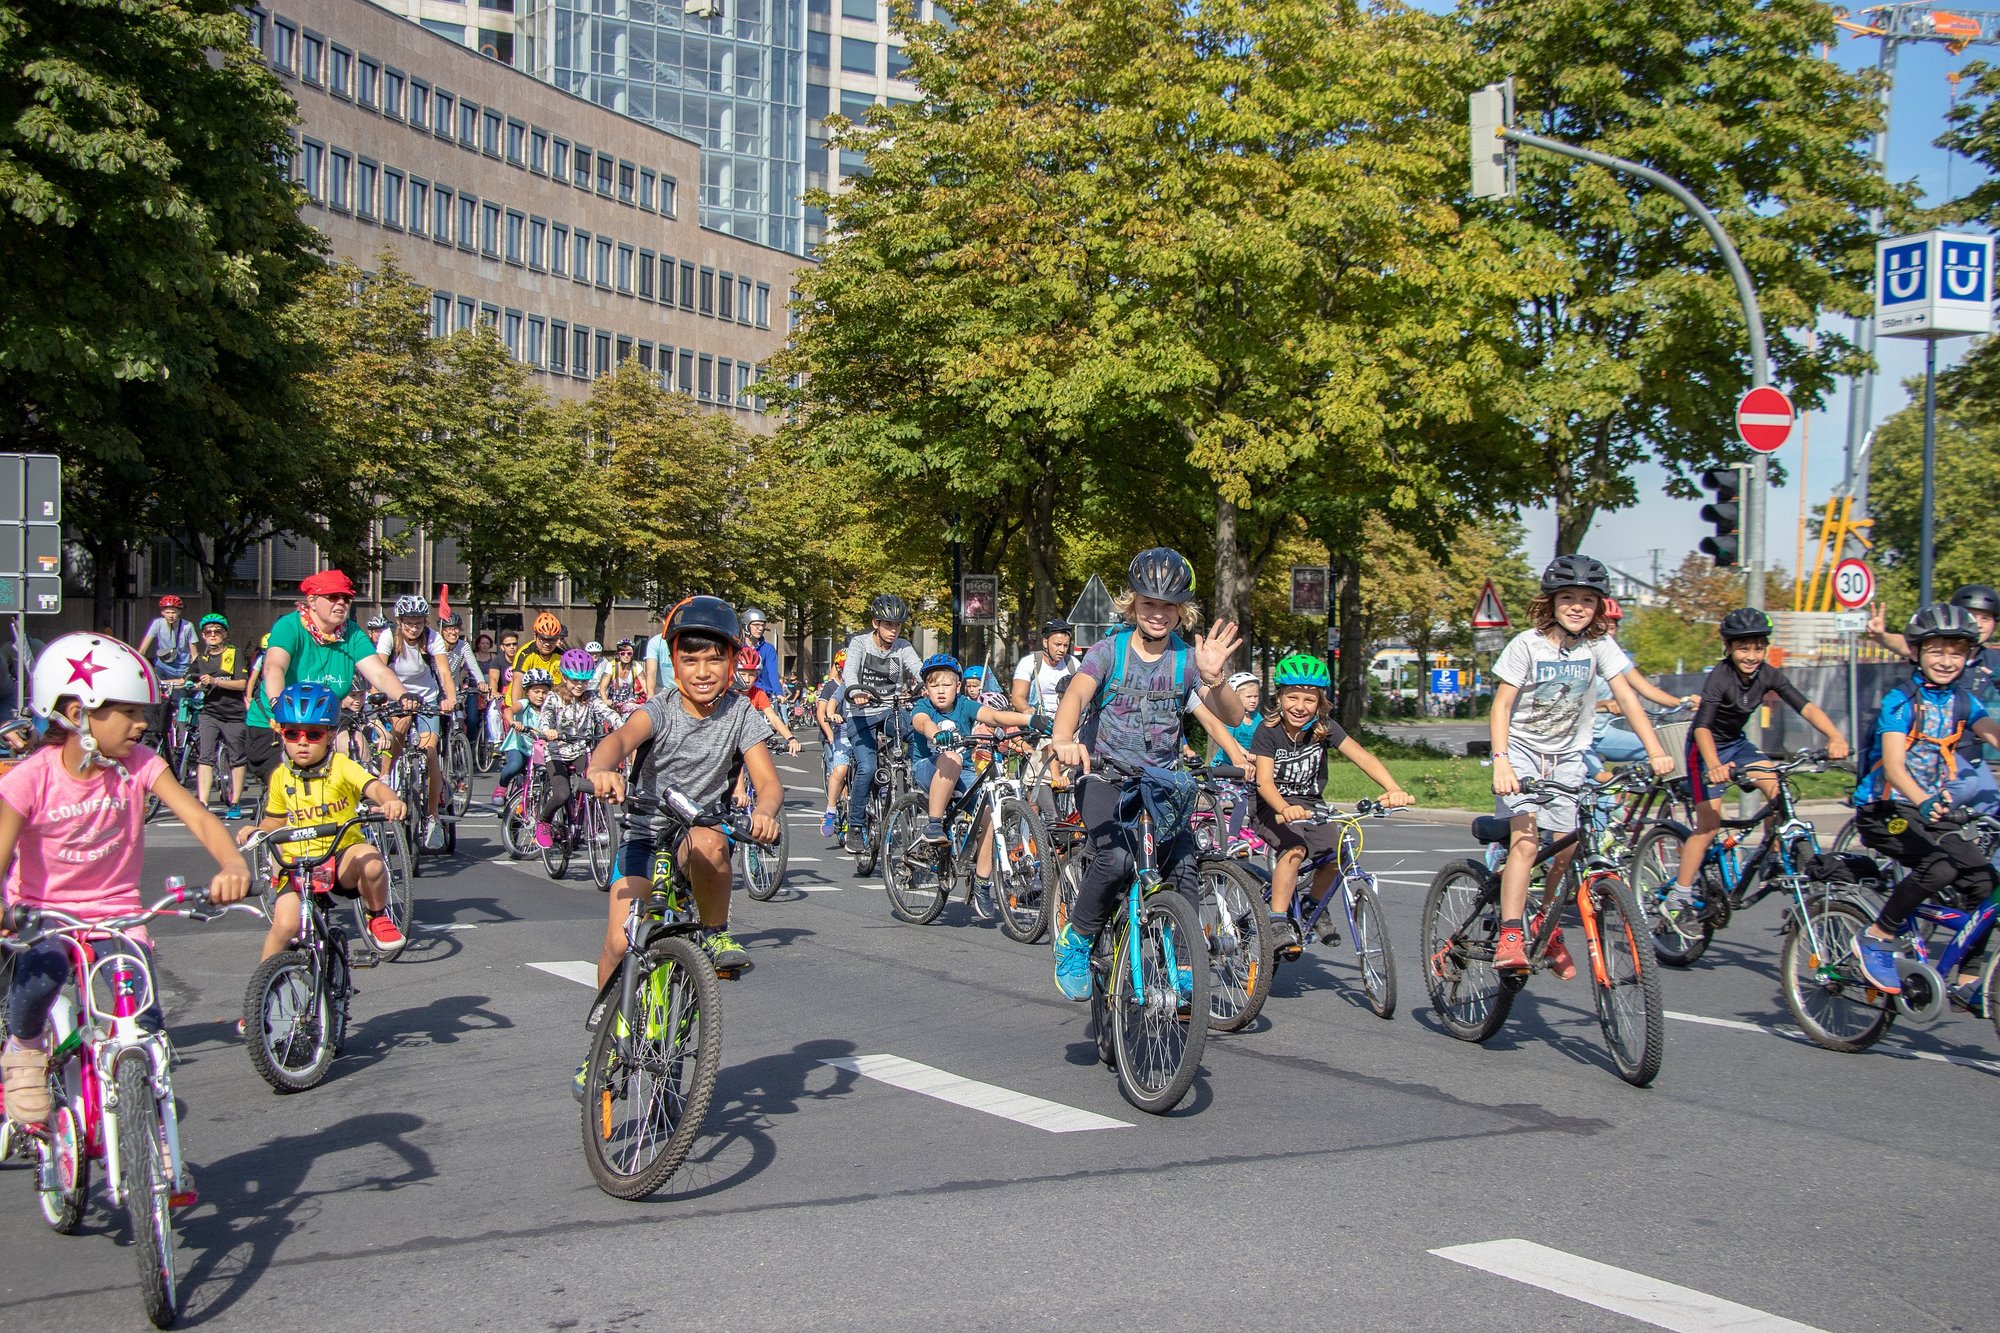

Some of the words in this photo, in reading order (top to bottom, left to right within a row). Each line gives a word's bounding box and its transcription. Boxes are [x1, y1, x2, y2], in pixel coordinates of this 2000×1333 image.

[1841, 572, 1863, 594] 30
[1540, 666, 1556, 681] I'D
[58, 849, 84, 862] ALL
